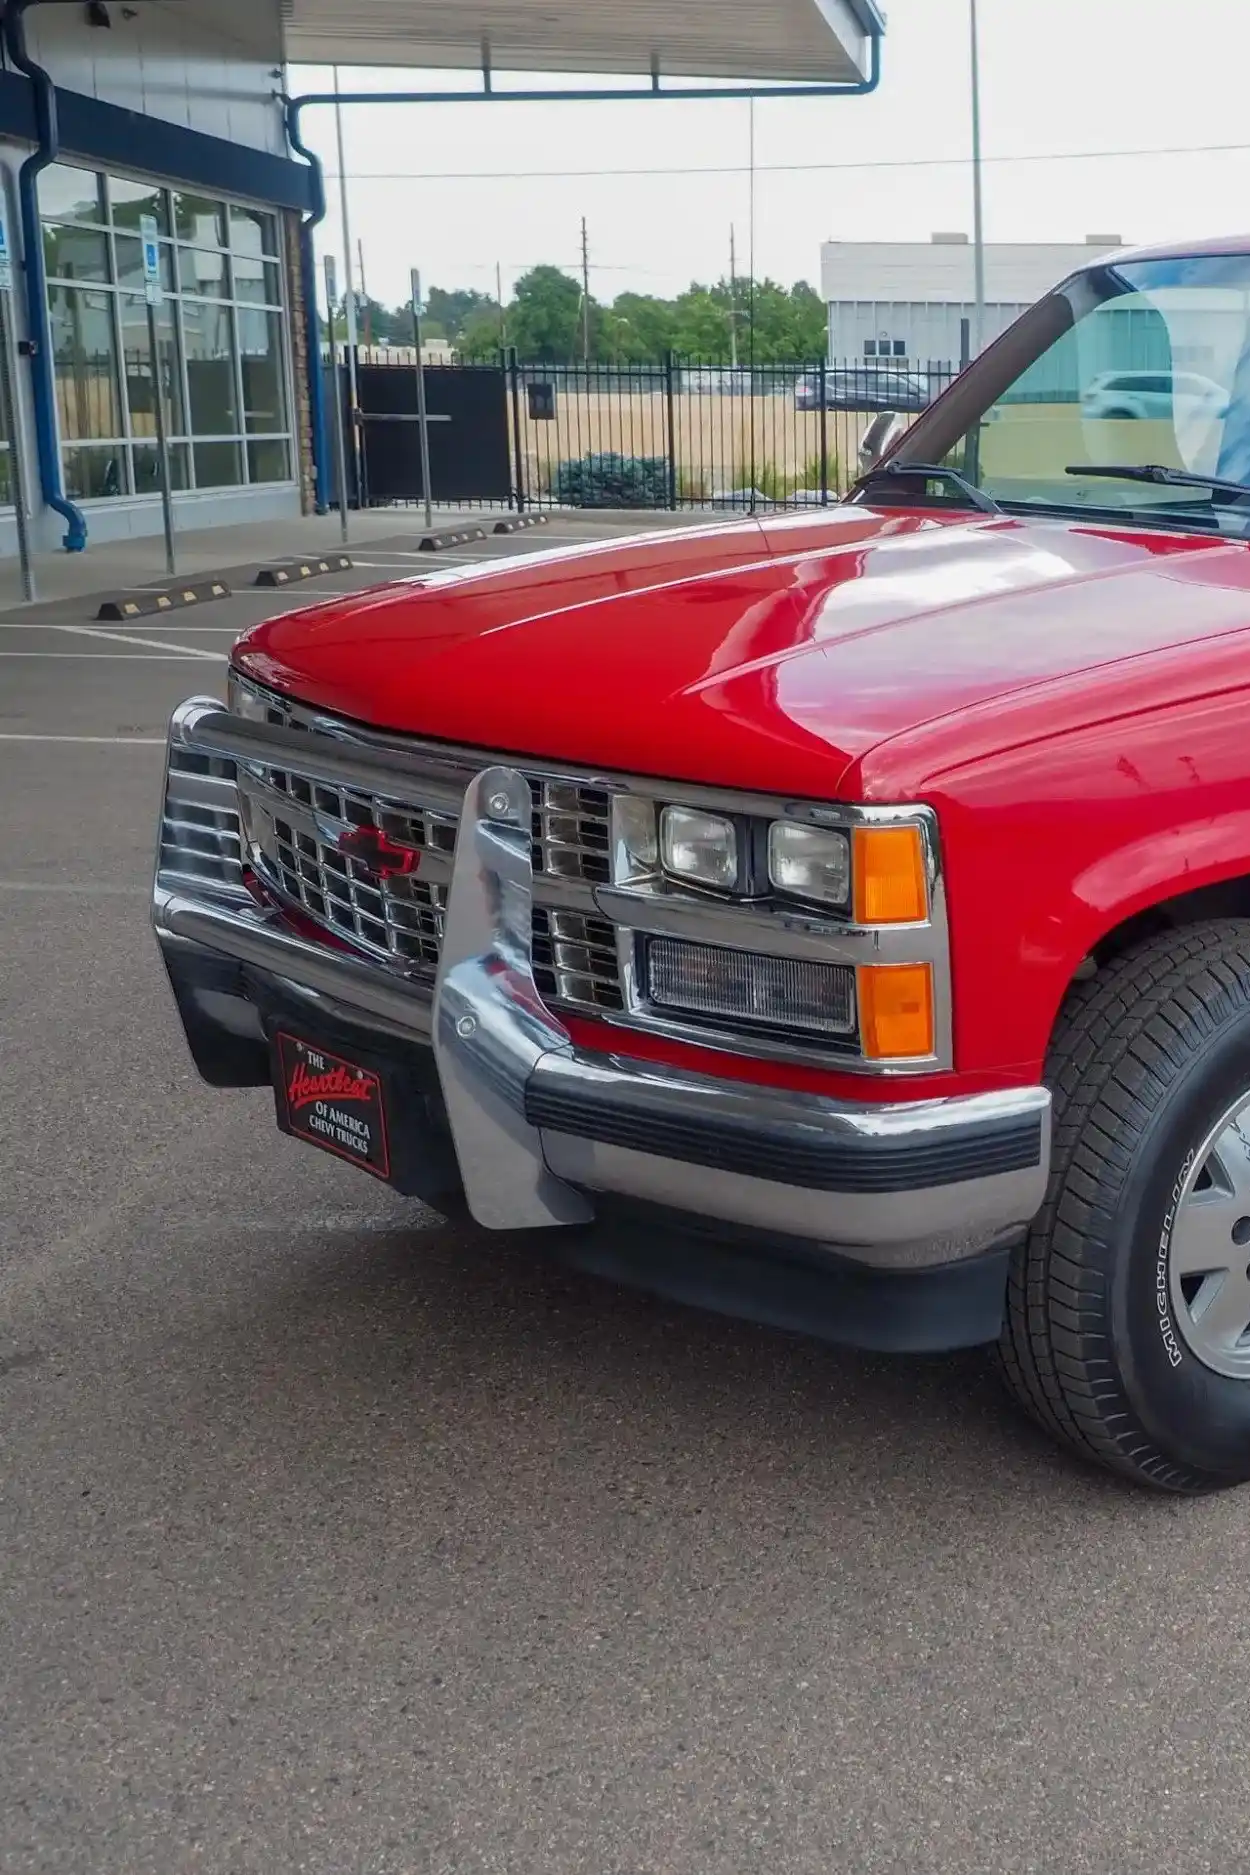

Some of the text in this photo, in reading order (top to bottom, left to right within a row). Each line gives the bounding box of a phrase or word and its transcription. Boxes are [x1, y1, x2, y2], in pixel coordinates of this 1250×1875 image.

[307, 1050, 325, 1070] THE
[288, 1062, 376, 1101] Heartbeat
[308, 1113, 369, 1154] CHEVY TRUCKS
[315, 1101, 371, 1139] OF AMERICA
